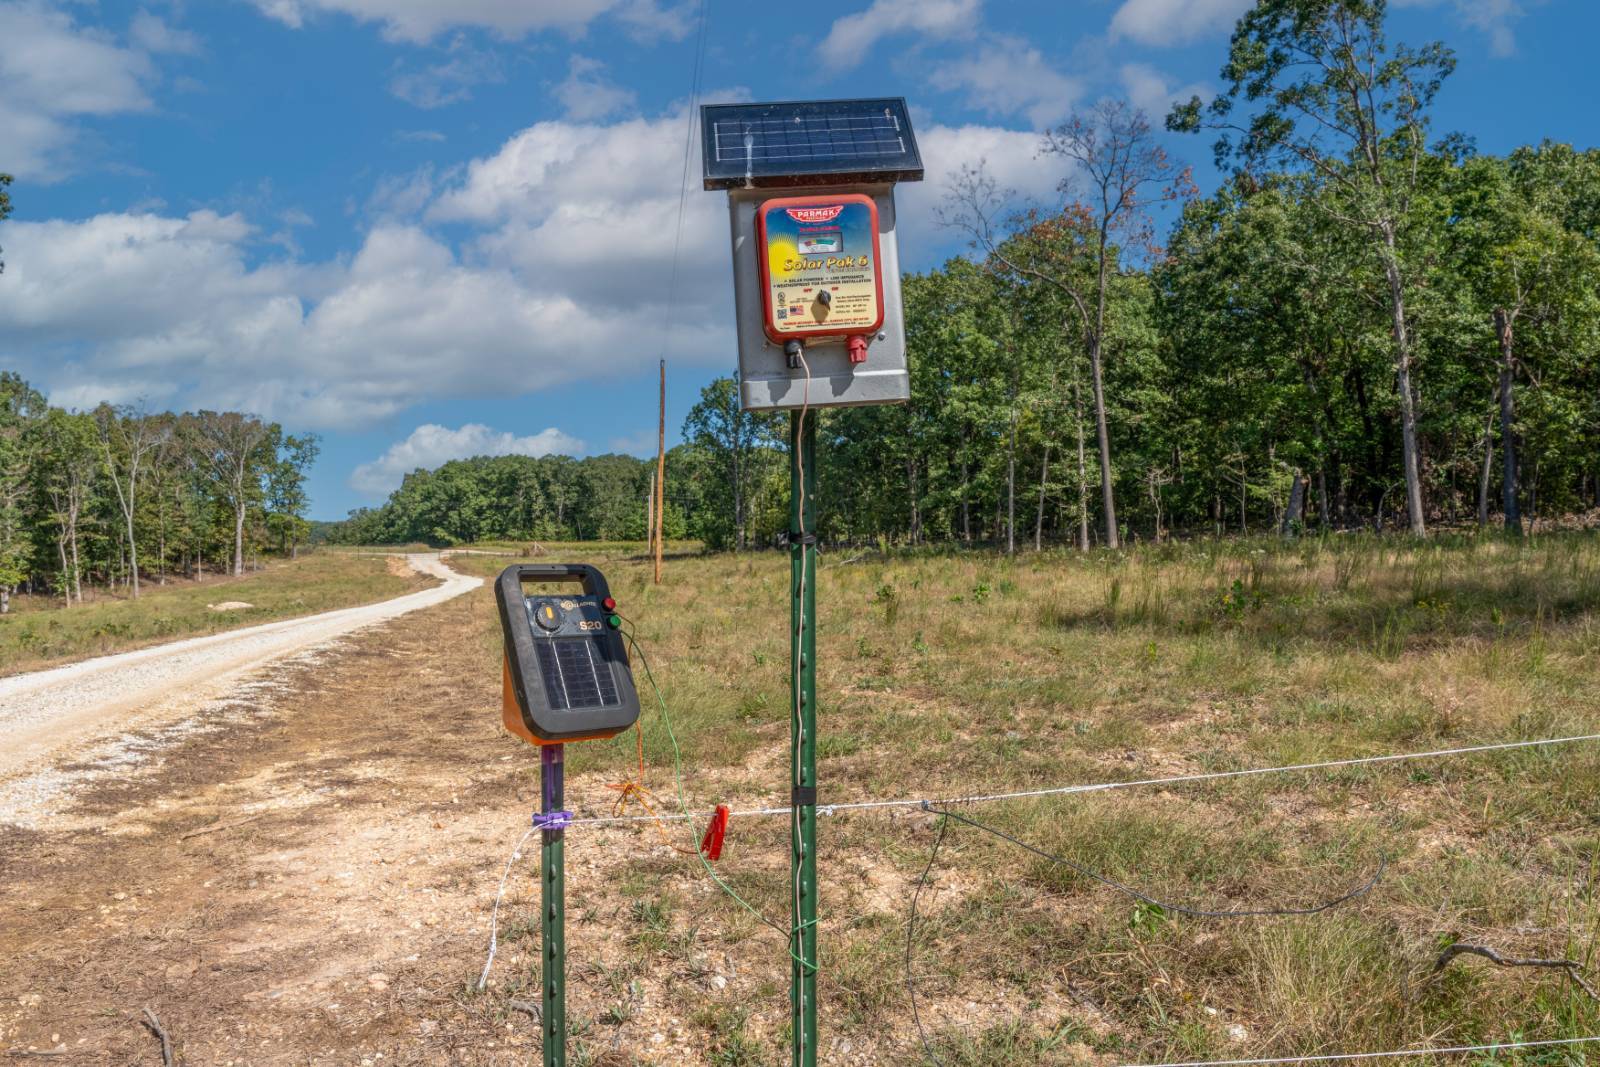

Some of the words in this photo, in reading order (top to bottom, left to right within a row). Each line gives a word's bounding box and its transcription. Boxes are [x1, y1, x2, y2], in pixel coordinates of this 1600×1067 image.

[797, 209, 835, 218] PARMAK
[783, 257, 824, 272] Solar
[826, 256, 854, 270] Pak
[858, 255, 868, 268] 6
[580, 621, 602, 630] S20
